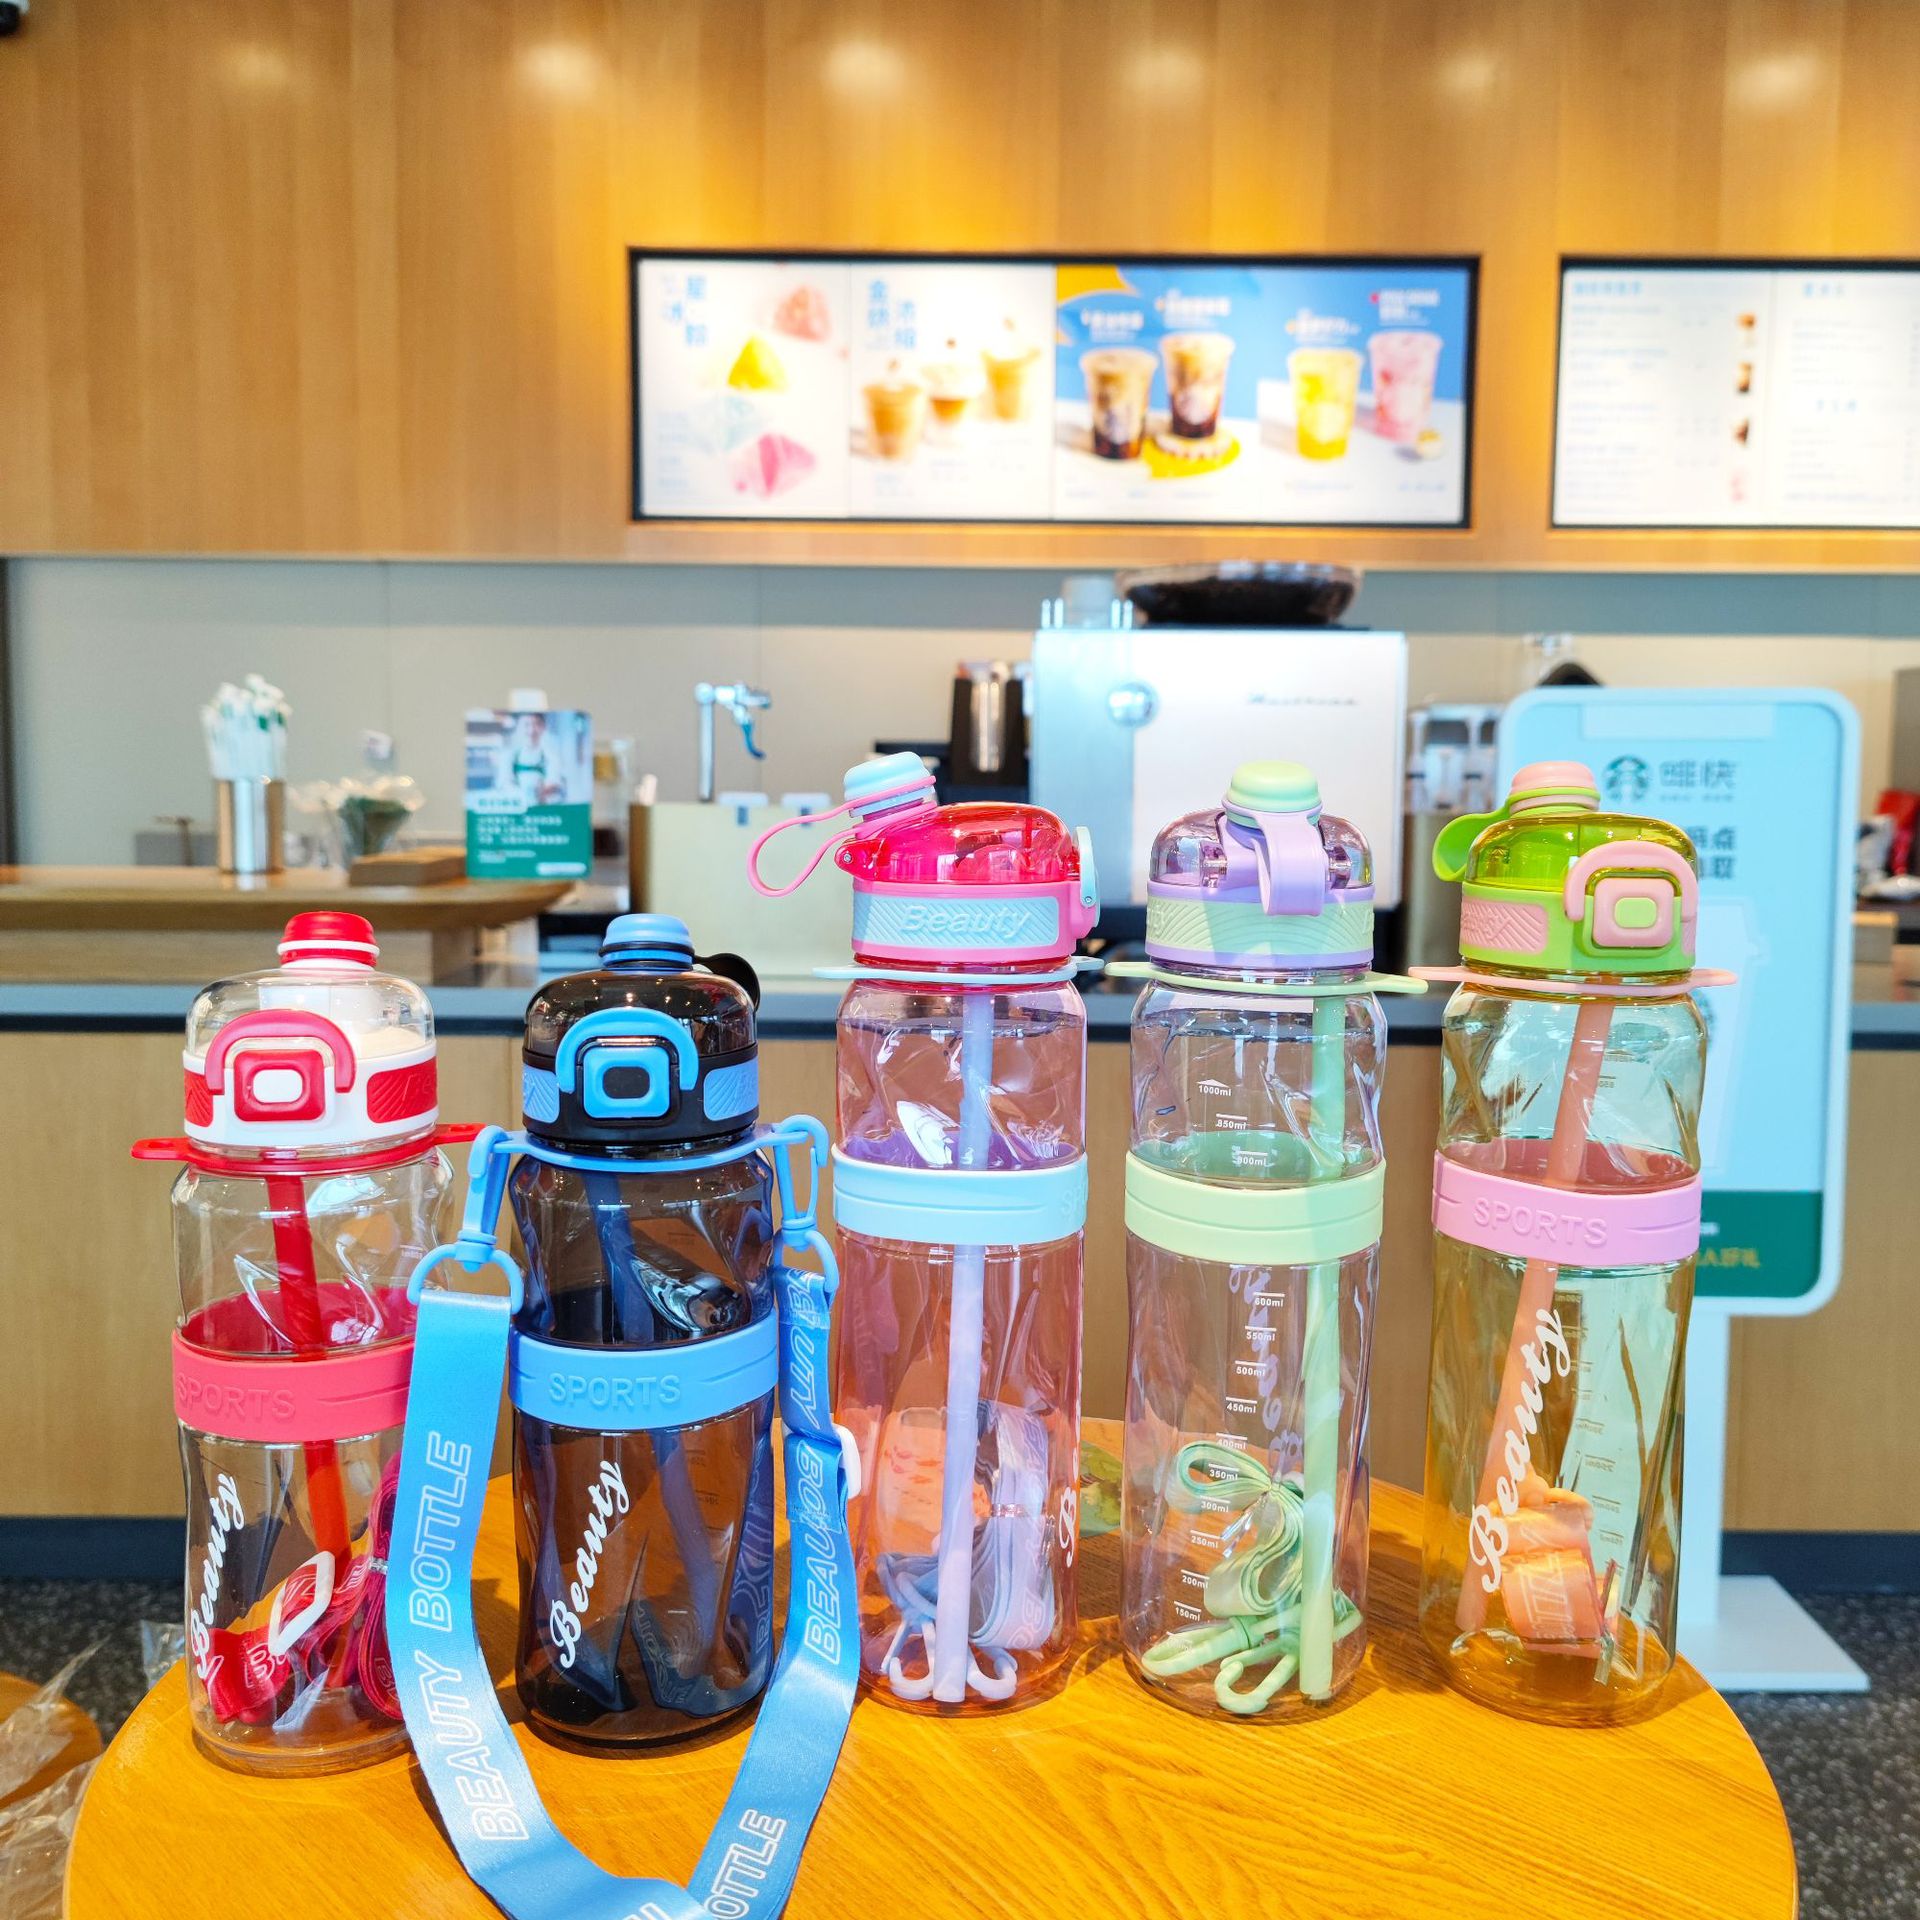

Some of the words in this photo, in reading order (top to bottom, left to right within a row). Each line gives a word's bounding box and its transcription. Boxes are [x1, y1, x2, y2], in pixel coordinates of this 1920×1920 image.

[901, 904, 1031, 939] Beauty
[1198, 1085, 1232, 1097] 1000ml
[1217, 1119, 1247, 1130] 850ml
[1472, 1196, 1609, 1247] SPORTS
[1254, 1297, 1284, 1308] 600ml
[1246, 1330, 1276, 1342] 550ml
[789, 1325, 821, 1430] UTY
[1236, 1366, 1267, 1377] 500ml
[177, 1372, 297, 1423] SPORTS
[549, 1372, 682, 1409] SPORTS
[1227, 1402, 1257, 1414] 450ml
[1218, 1438, 1247, 1450] 400ml
[1469, 1307, 1571, 1594] Beauty
[1209, 1469, 1239, 1481] 350ml
[1200, 1501, 1230, 1513] 300ml
[409, 1430, 472, 1633] BOTTLE
[1191, 1535, 1219, 1549] 250ml
[190, 1473, 245, 1680] Beauty
[549, 1460, 630, 1669] Beauty
[802, 1522, 841, 1665] BEAU
[1182, 1575, 1209, 1589] 200ml
[1174, 1606, 1201, 1622] 150ml
[413, 1649, 530, 1841] BEAUTY
[703, 1808, 787, 1920] OTTLE
